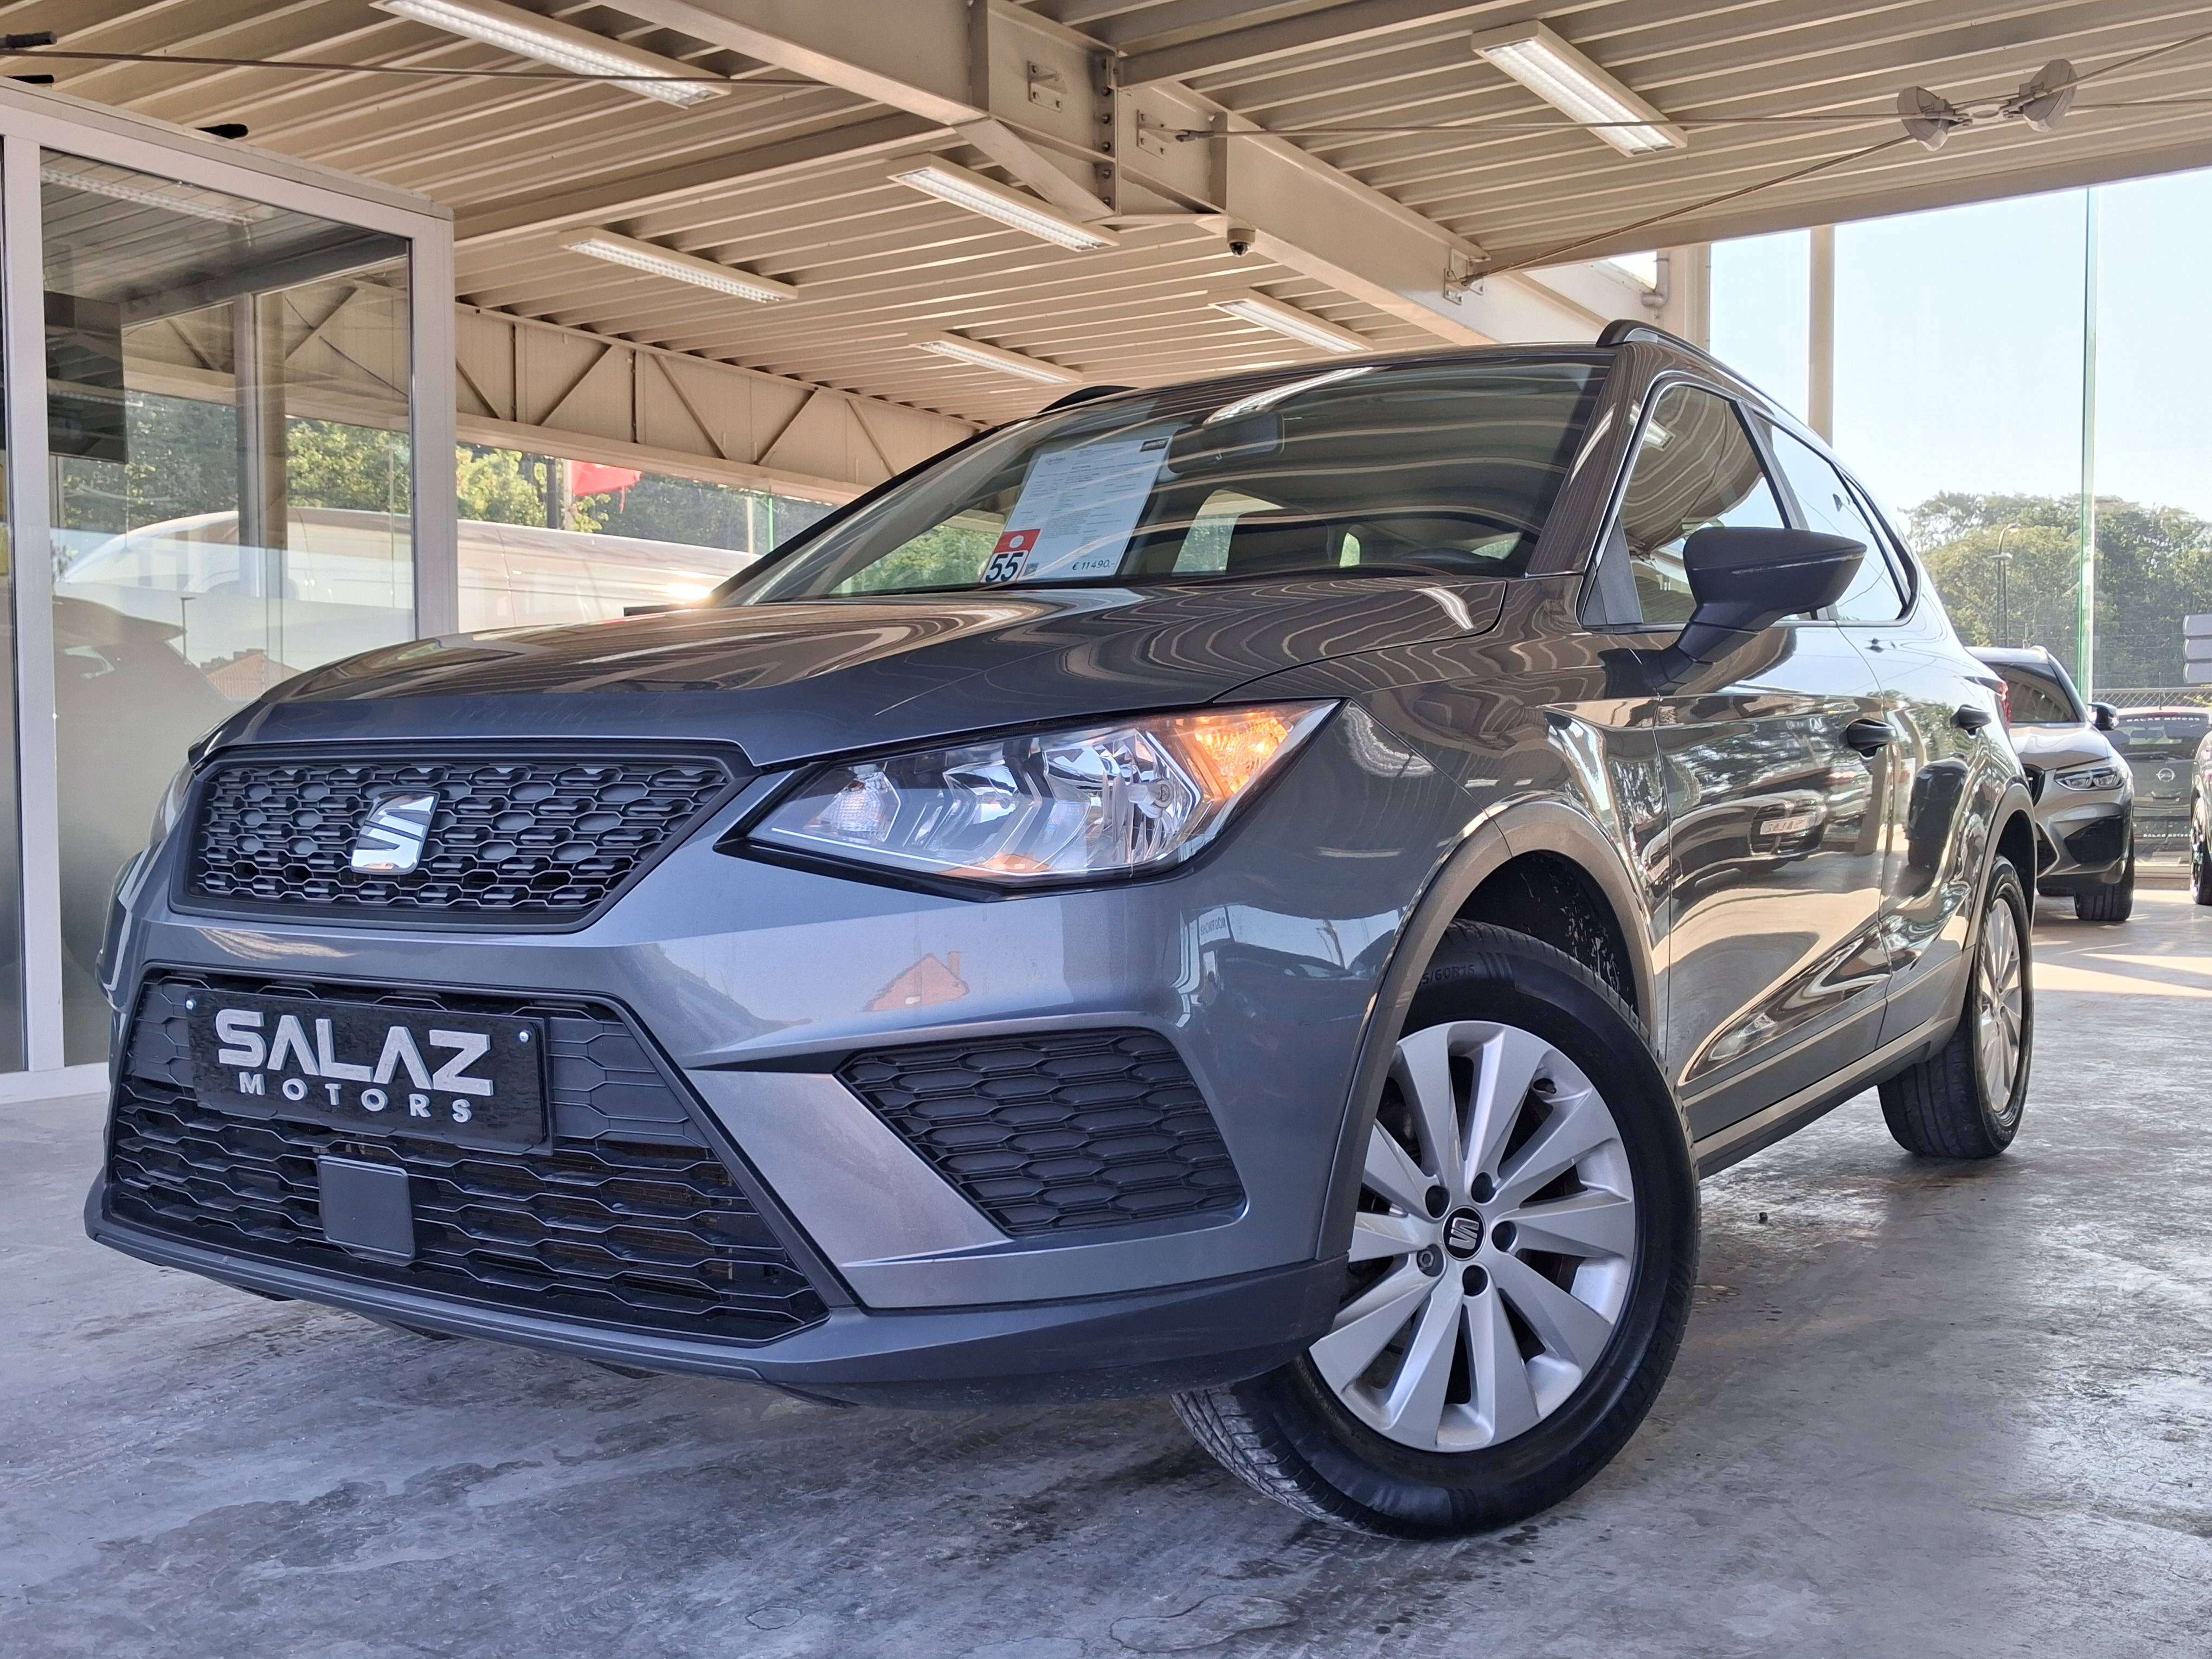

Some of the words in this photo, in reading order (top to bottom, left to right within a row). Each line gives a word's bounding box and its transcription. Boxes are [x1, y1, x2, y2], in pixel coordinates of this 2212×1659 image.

[986, 551, 1024, 582] 55
[215, 1008, 494, 1096] SALAZ
[239, 1071, 473, 1123] MOTORS
